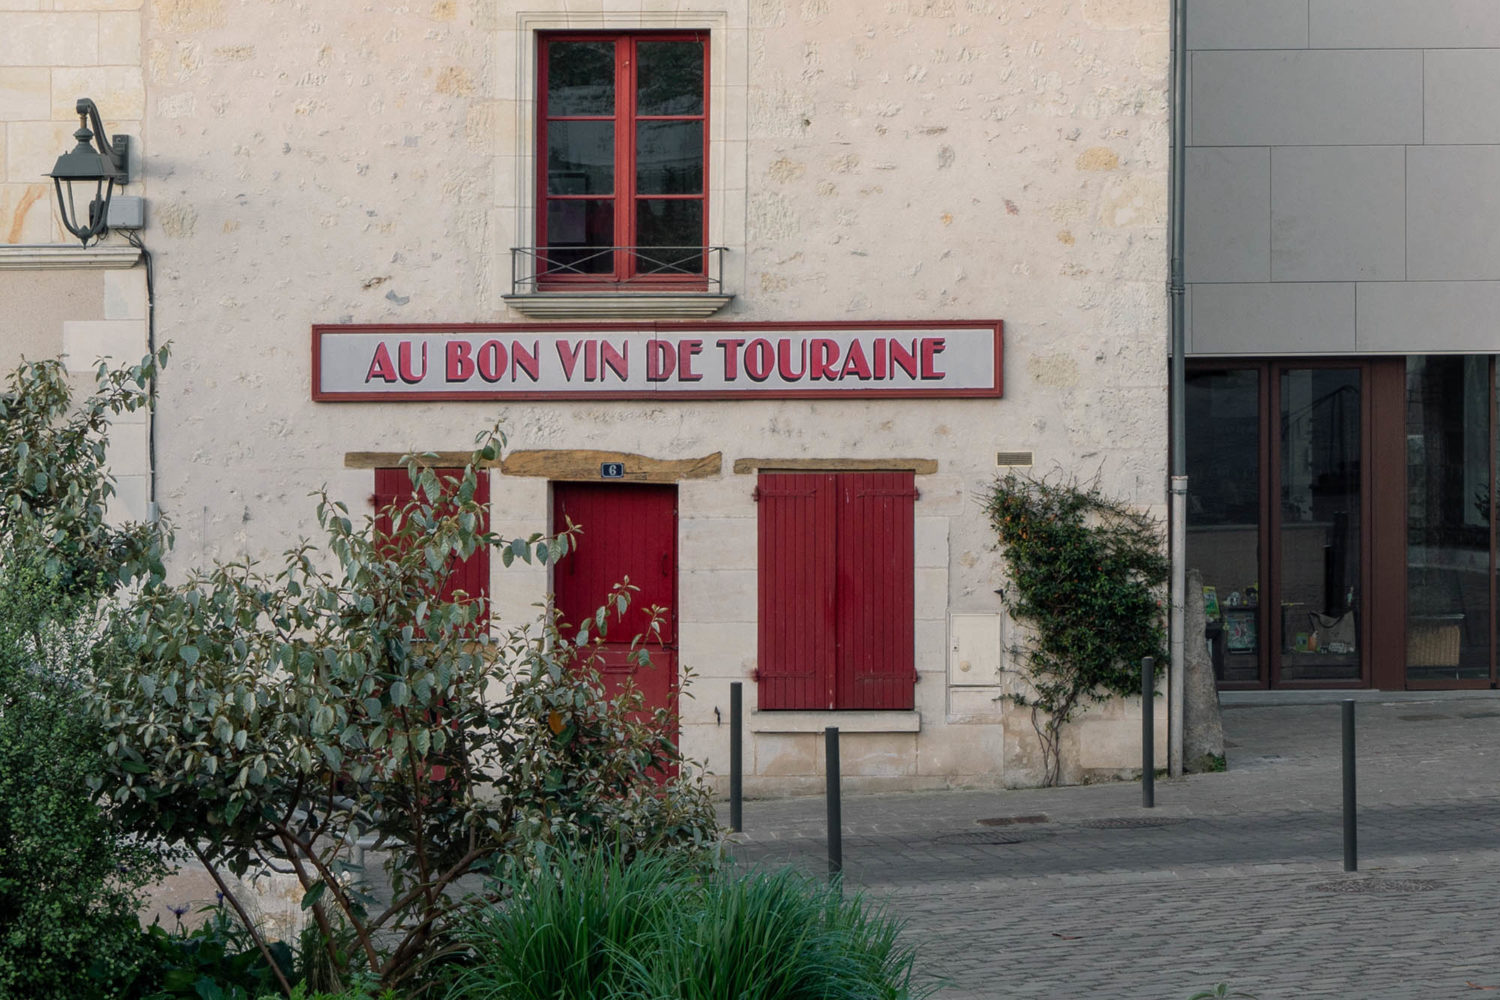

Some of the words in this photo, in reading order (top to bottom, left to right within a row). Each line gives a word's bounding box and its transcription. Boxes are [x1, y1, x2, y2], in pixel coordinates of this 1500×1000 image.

[365, 340, 427, 384] AU
[446, 340, 540, 384] BON
[555, 339, 629, 383] VIN
[646, 339, 703, 383] DE
[716, 338, 946, 383] TOURAINE
[609, 464, 617, 476] 6
